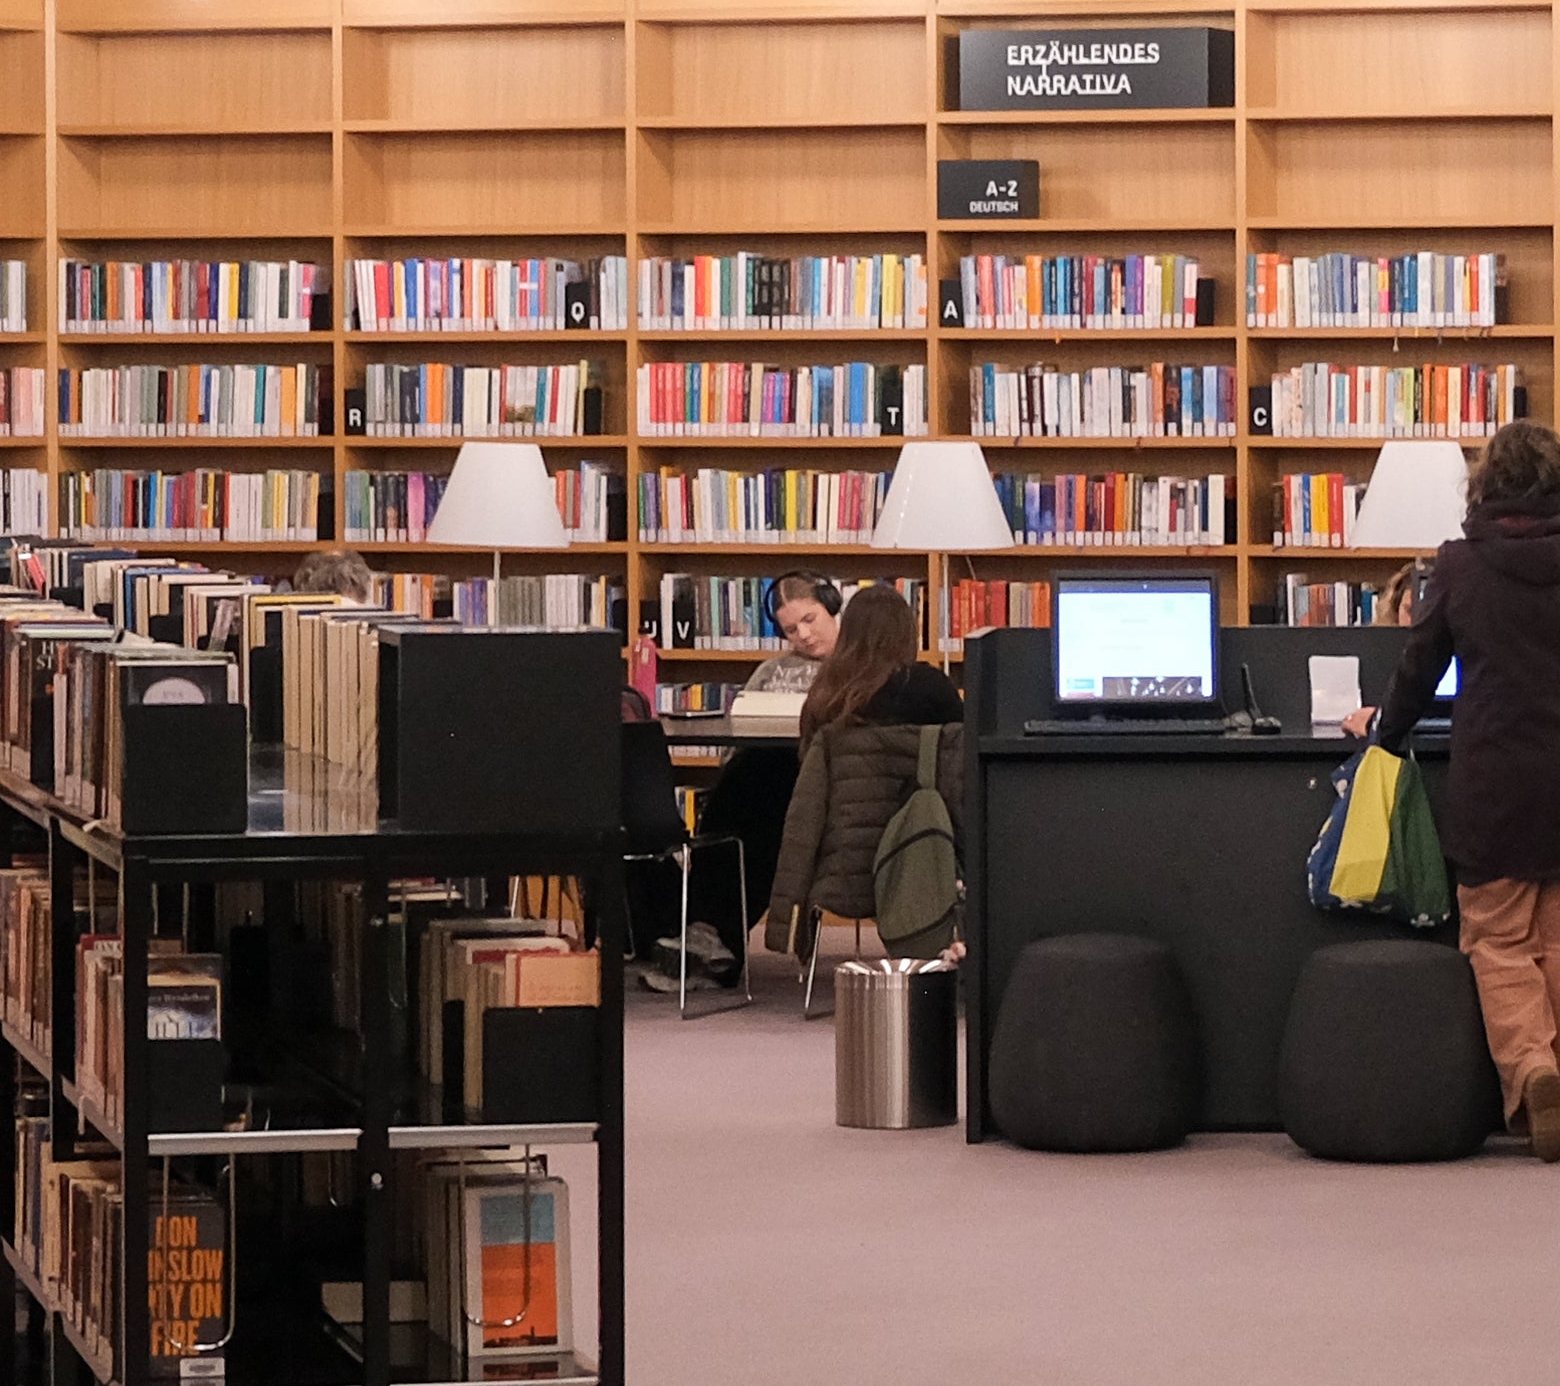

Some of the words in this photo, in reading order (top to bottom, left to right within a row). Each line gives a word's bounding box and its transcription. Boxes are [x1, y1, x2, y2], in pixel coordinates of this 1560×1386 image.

[1007, 40, 1159, 65] ERZÄHLENDES
[1007, 75, 1131, 96] NARRATIVA
[987, 180, 1017, 197] A-Z
[969, 201, 1018, 213] DEUTSCH
[571, 302, 585, 323] Q
[944, 300, 957, 318] A
[350, 409, 361, 426] R
[887, 406, 899, 426] T
[1253, 406, 1266, 426] C
[676, 621, 690, 639] V
[147, 1249, 224, 1281] INSLOW
[189, 1283, 223, 1318] ON
